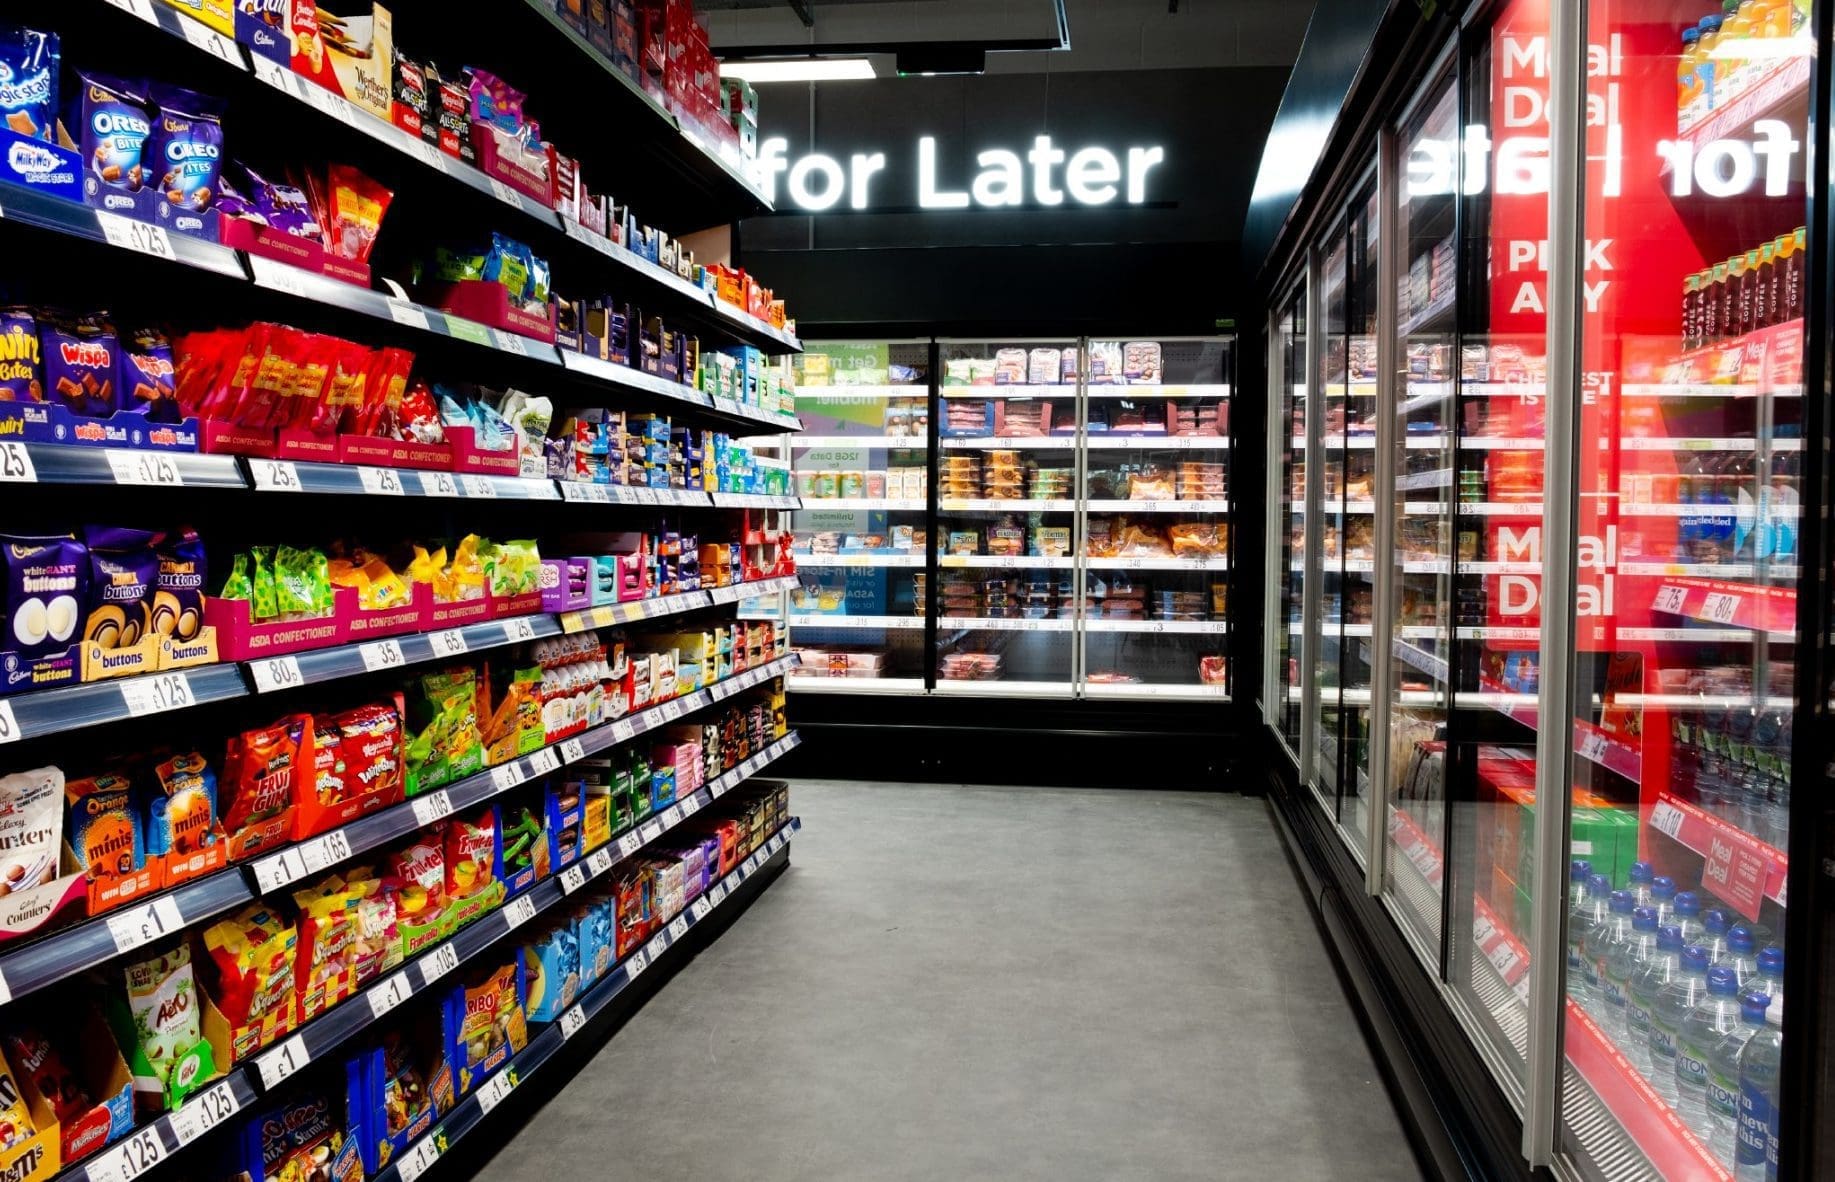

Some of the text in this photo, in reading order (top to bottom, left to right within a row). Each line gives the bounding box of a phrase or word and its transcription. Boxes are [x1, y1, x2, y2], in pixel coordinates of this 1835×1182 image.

[1503, 33, 1621, 78] Mal
[1504, 83, 1620, 127] Dal
[167, 141, 221, 160] OREO
[184, 161, 213, 175] ITES
[757, 135, 1164, 211] for Later
[1509, 239, 1614, 272] PIK
[1509, 281, 1611, 314] AY
[62, 344, 110, 368] Wispa
[1504, 372, 1614, 387] CHEEST
[1497, 525, 1617, 568] Mal
[103, 584, 147, 600] buttons
[1498, 574, 1614, 616] Dal
[350, 611, 420, 631] ASDA CONFECTIONERY
[249, 625, 337, 648] ASDA CONFECTIONERY
[102, 651, 143, 669] buttons
[172, 645, 208, 660] buttons
[32, 669, 73, 684] buttons
[175, 805, 210, 834] minis
[88, 829, 132, 862] minis
[274, 857, 292, 885] £1
[141, 904, 165, 941] £1
[157, 992, 189, 1028] Aero
[278, 1044, 297, 1078] £1
